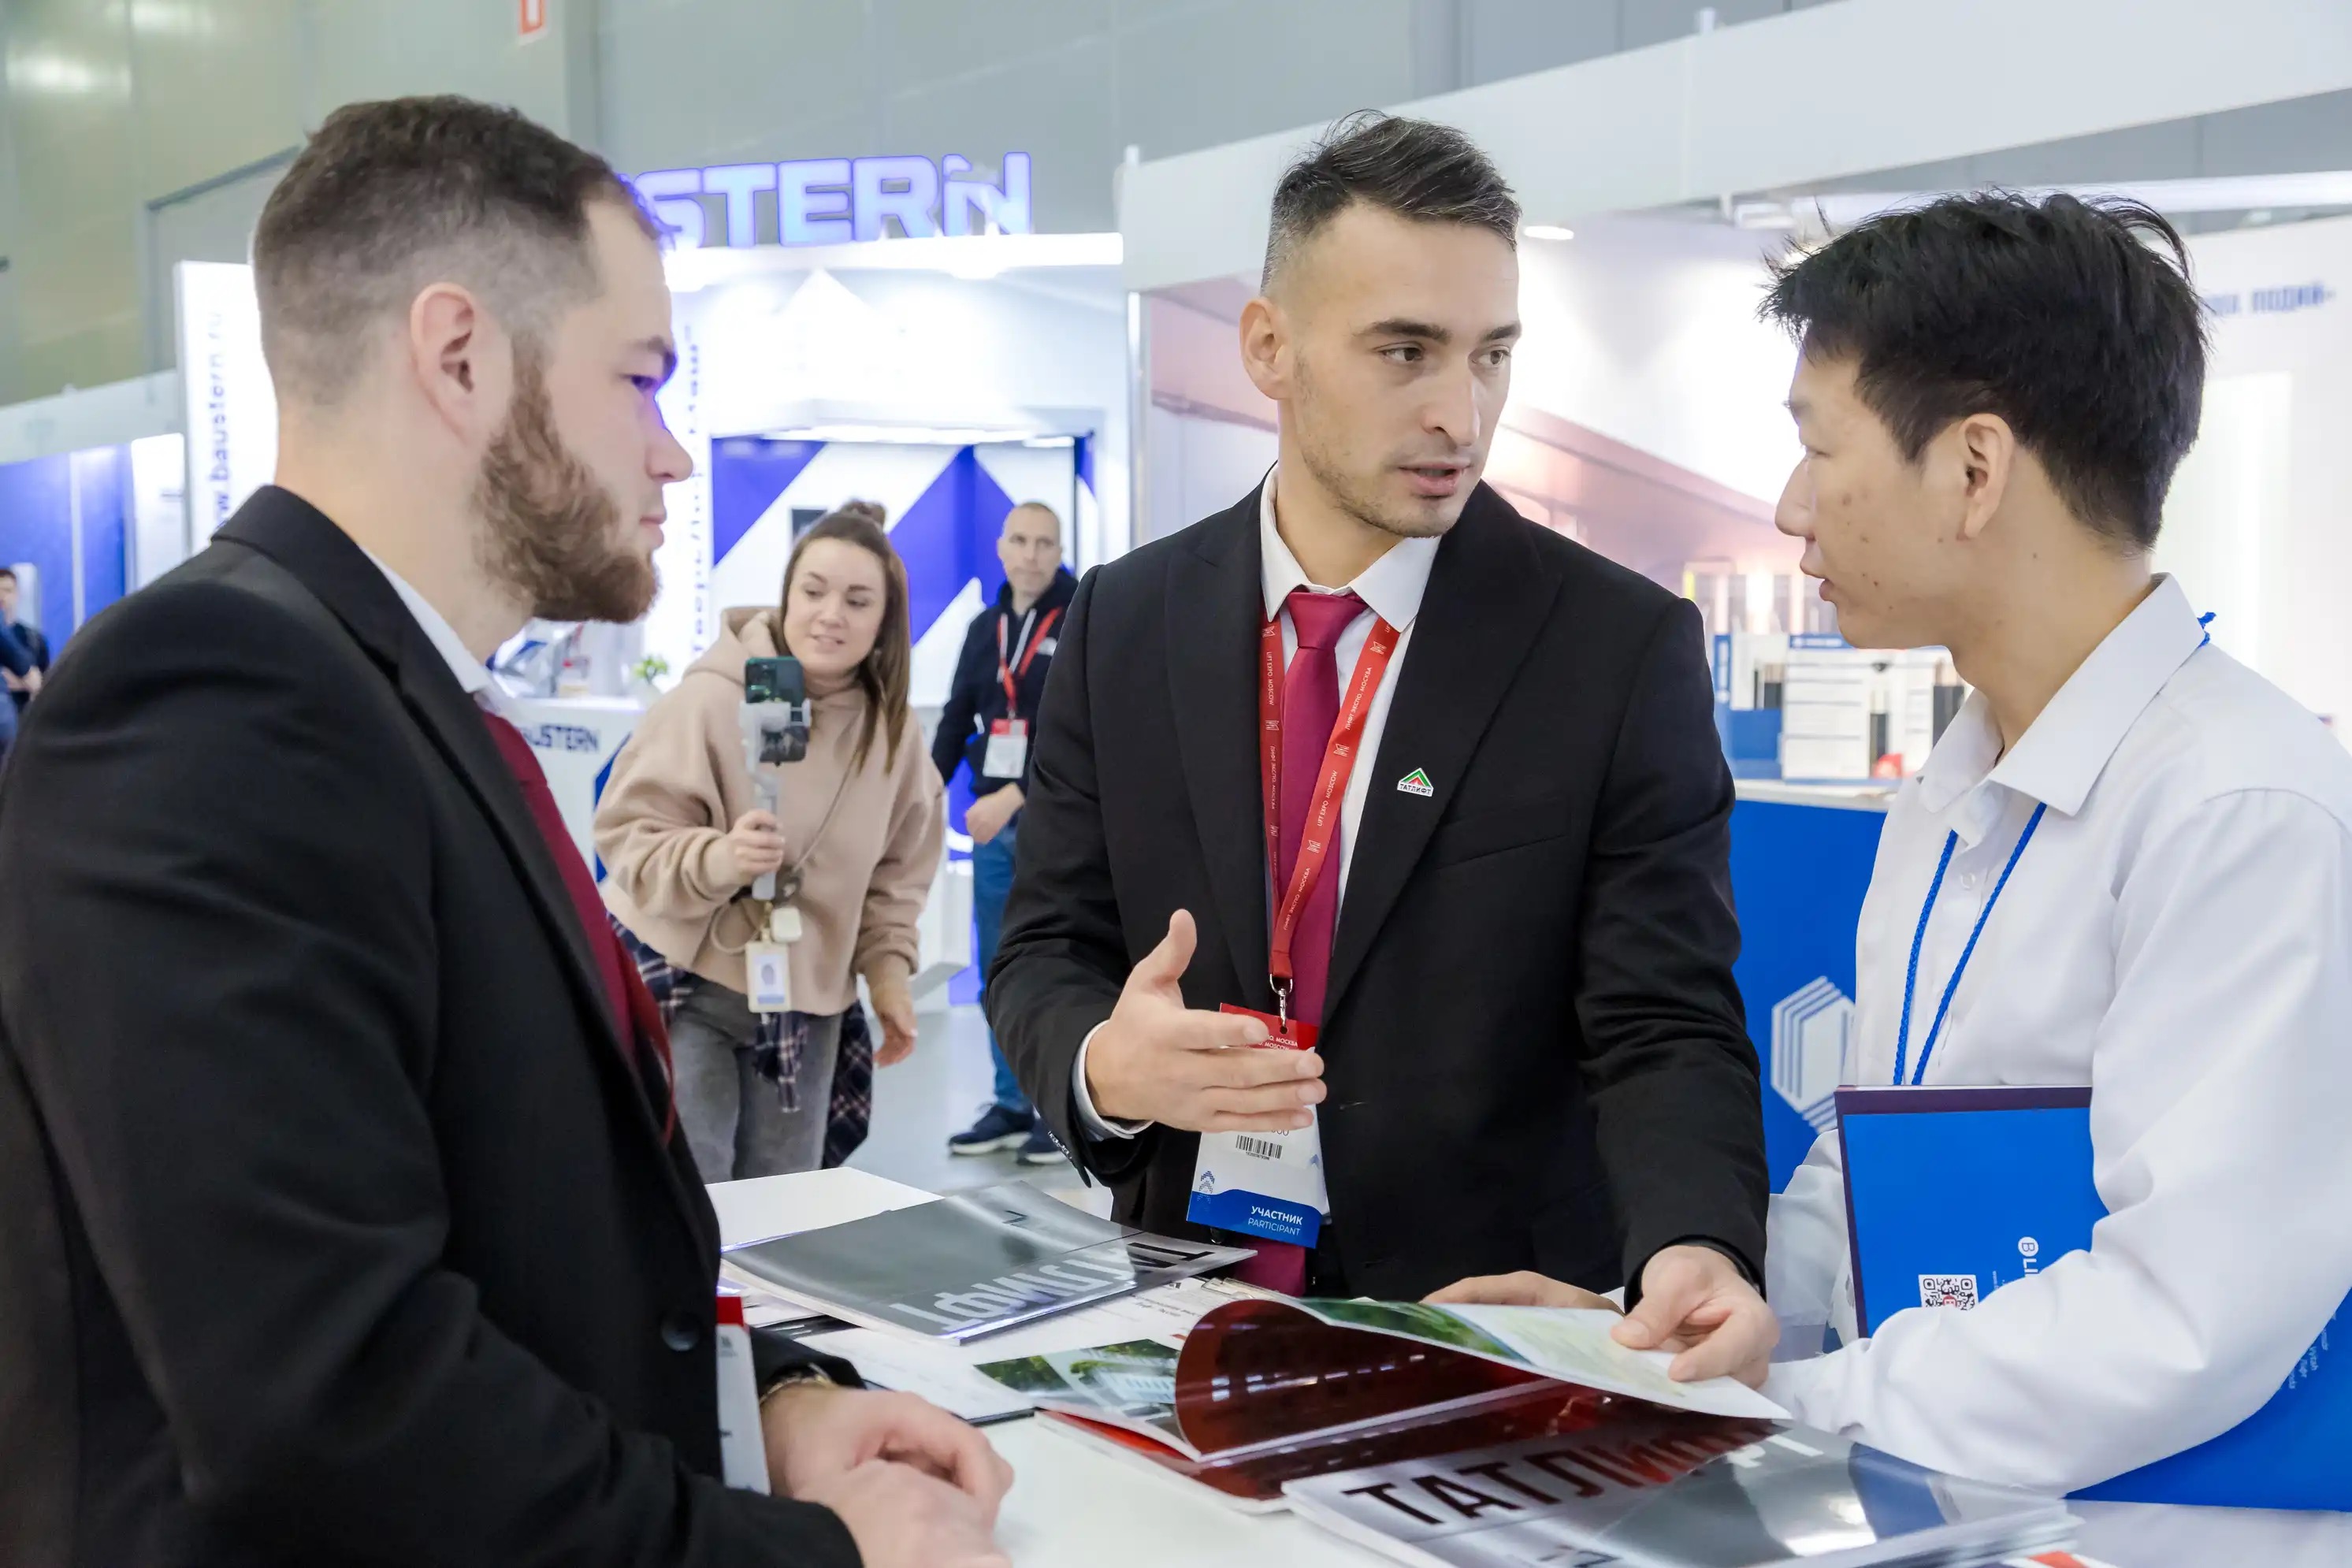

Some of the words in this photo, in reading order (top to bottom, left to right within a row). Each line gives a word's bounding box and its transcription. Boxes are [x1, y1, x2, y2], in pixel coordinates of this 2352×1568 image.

[1344, 713, 1356, 730] ЛИФТ
[1360, 667, 1373, 692] МОСКВА
[1326, 770, 1338, 799] MOSCOW
[1399, 783, 1432, 794] ТАТЛИФТ
[1298, 867, 1310, 892] МОСКВА
[1276, 1037, 1298, 1047] МОСКВА
[1250, 1206, 1304, 1226] УЧАСТНИК
[1247, 1217, 1302, 1236] PARTICIPANT
